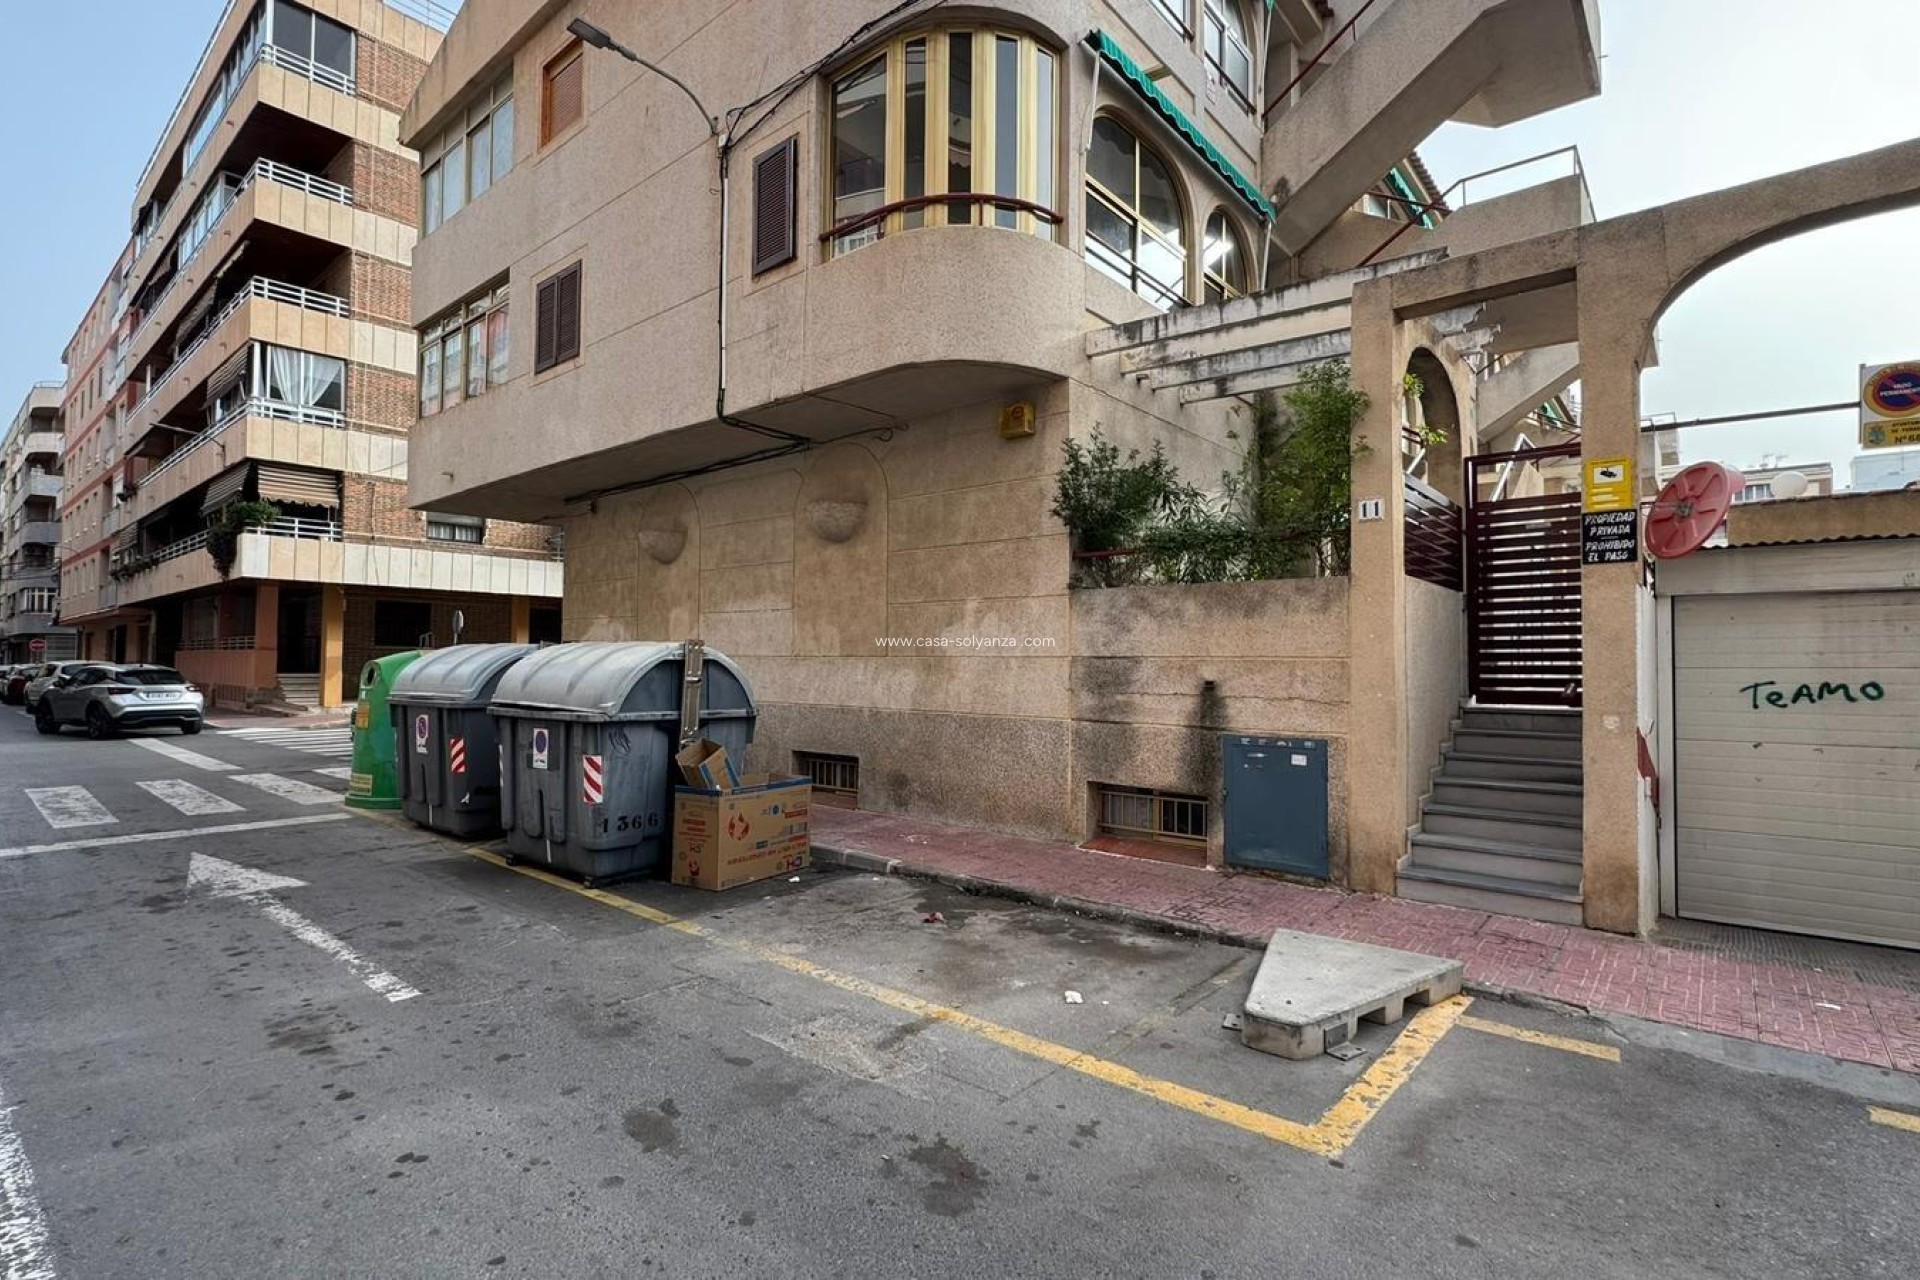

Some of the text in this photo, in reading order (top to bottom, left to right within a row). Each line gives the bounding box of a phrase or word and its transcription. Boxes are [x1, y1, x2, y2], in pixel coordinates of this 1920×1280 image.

[1362, 501, 1379, 518] 11
[1584, 512, 1636, 525] PROPIEDAD
[1589, 525, 1631, 536] PRIVADA
[1585, 539, 1635, 552] PROHIBIDO
[1587, 552, 1599, 562] EL
